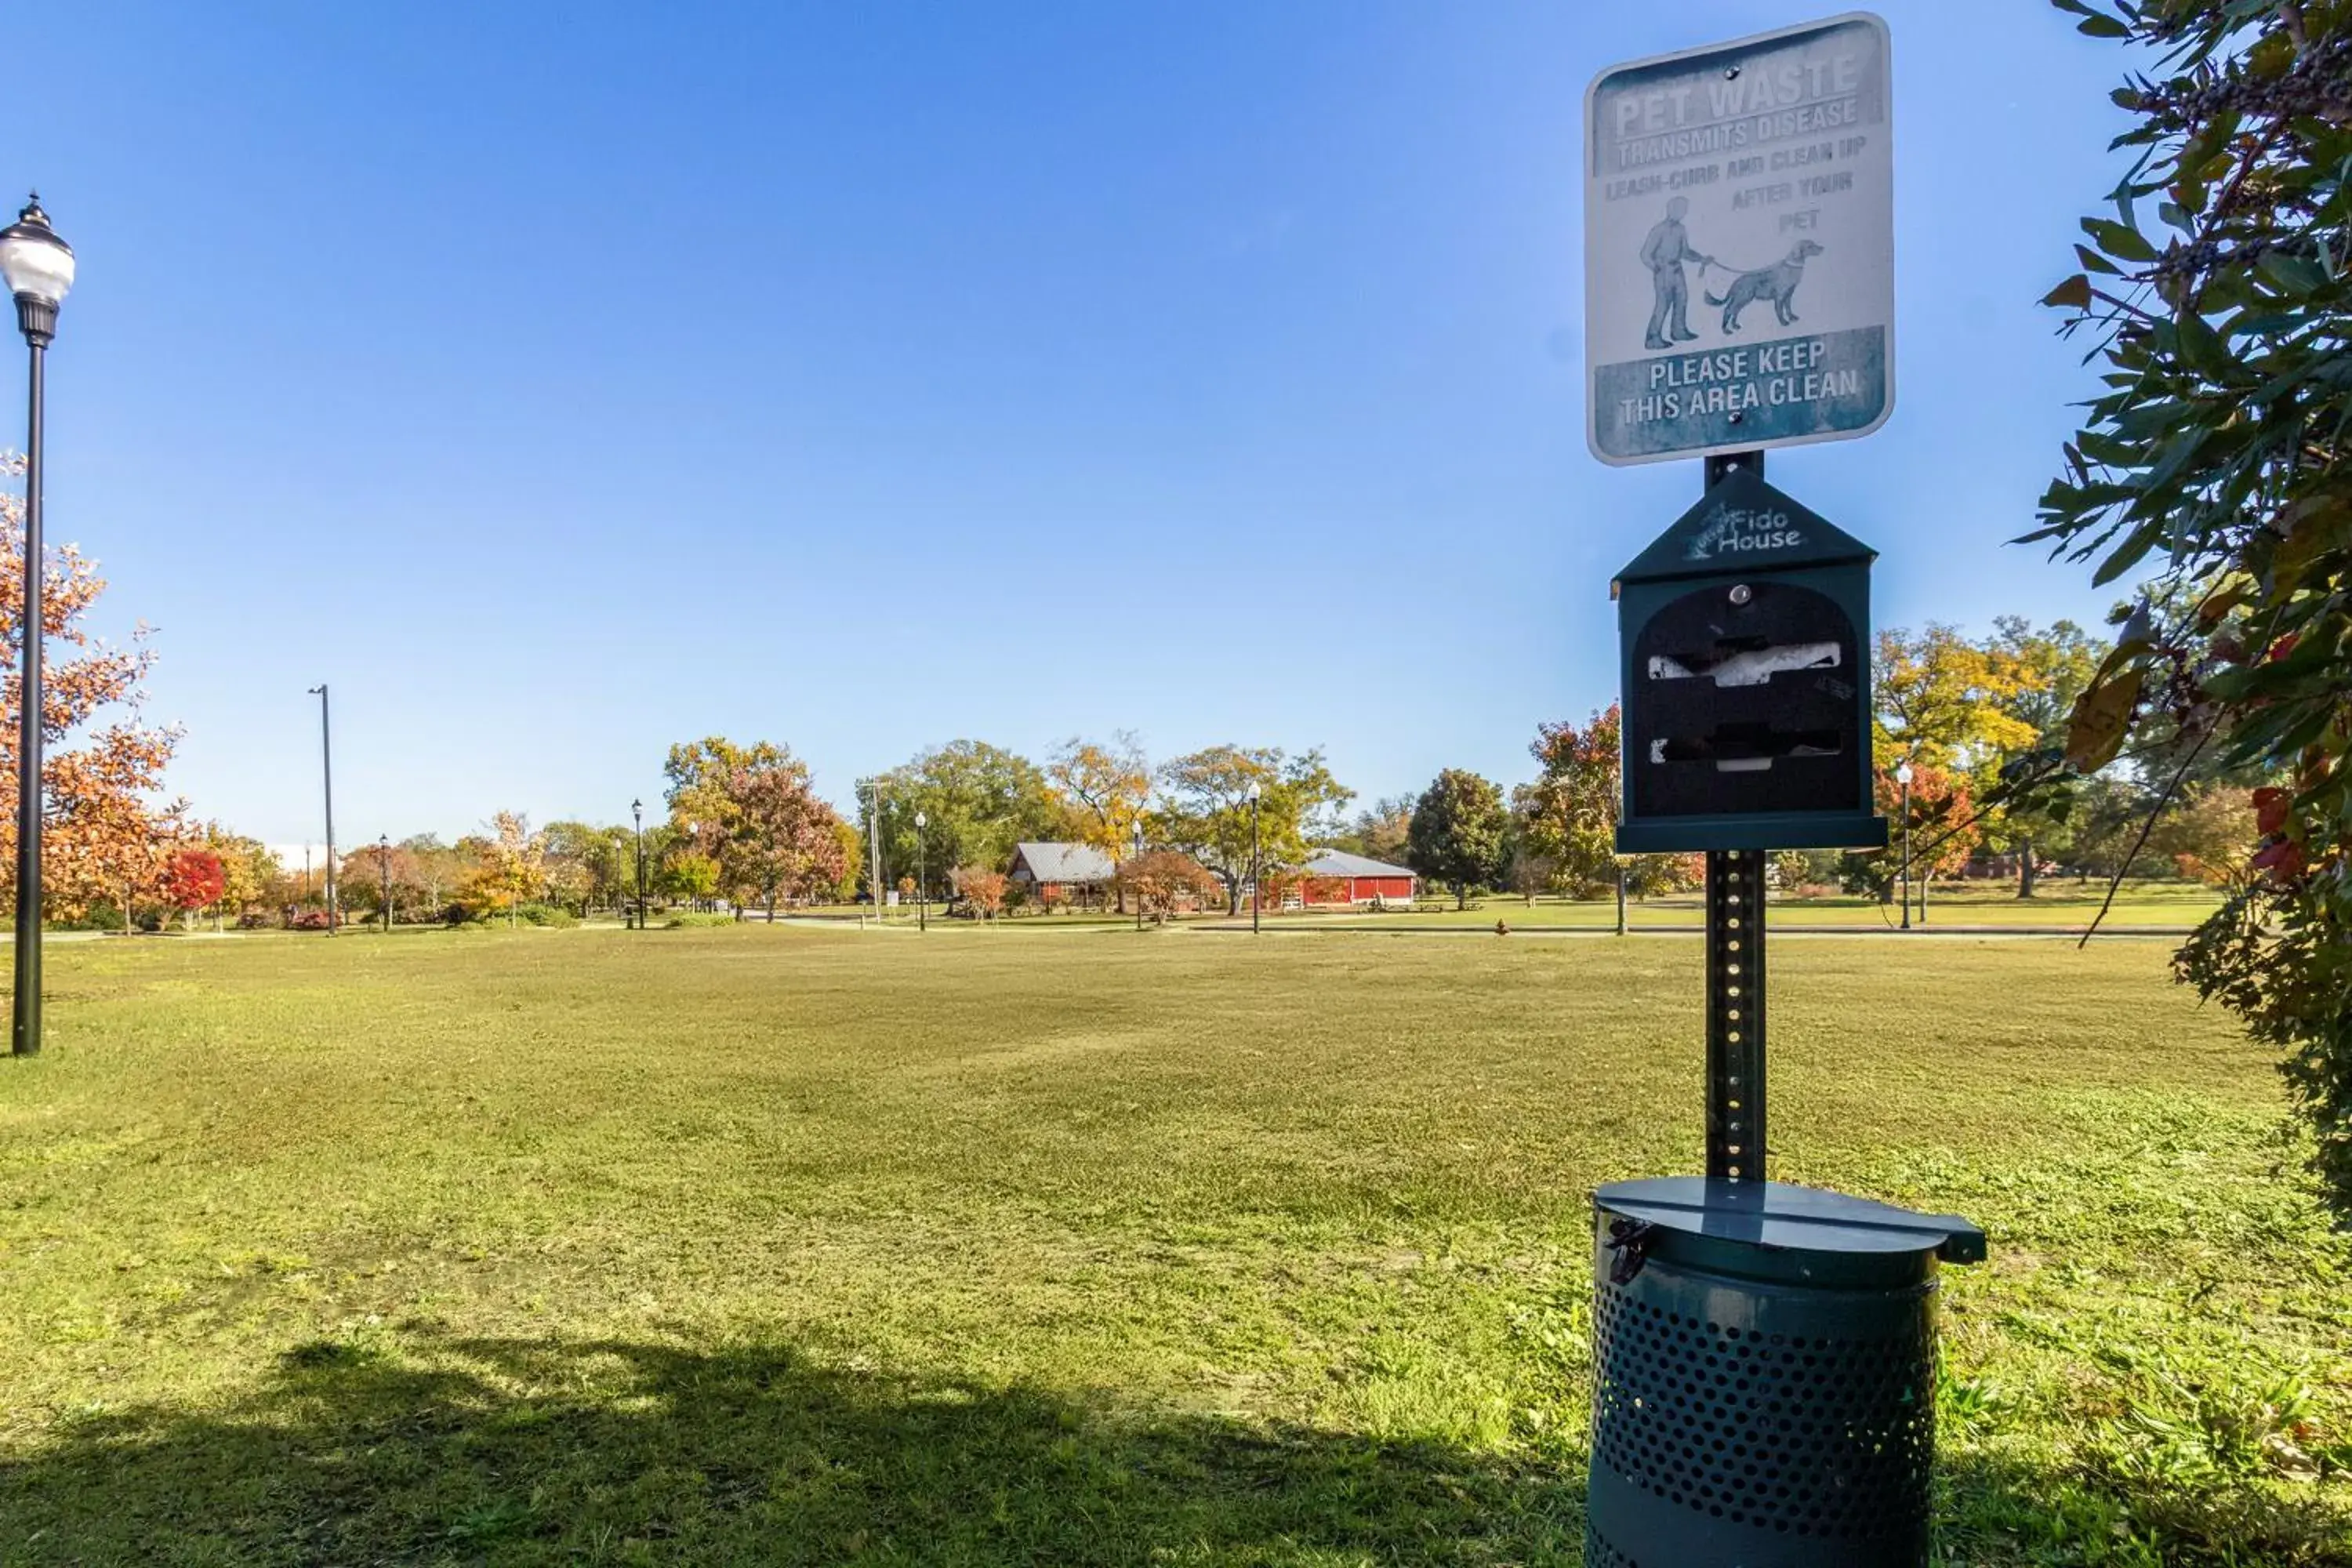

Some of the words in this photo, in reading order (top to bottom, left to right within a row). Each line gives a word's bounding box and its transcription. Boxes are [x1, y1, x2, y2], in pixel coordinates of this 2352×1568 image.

[1616, 89, 1690, 136] PET
[1708, 54, 1857, 118] WASTE
[1618, 122, 1747, 168] TRANSMITS
[1758, 99, 1857, 140] DISEASE
[1727, 156, 1764, 180] AND
[1770, 143, 1832, 170] CLEAN
[1838, 136, 1867, 158] UP
[1733, 183, 1791, 210] AFTER
[1798, 172, 1853, 197] YOUR
[1779, 209, 1820, 232] PET
[1650, 351, 1748, 390] PLEASE
[1759, 342, 1825, 373] KEEP
[1622, 395, 1679, 424] THIS
[1690, 383, 1759, 415] AREA
[1769, 370, 1857, 405] CLEAN
[1718, 530, 1802, 553] House
[1729, 507, 1788, 532] Fido
